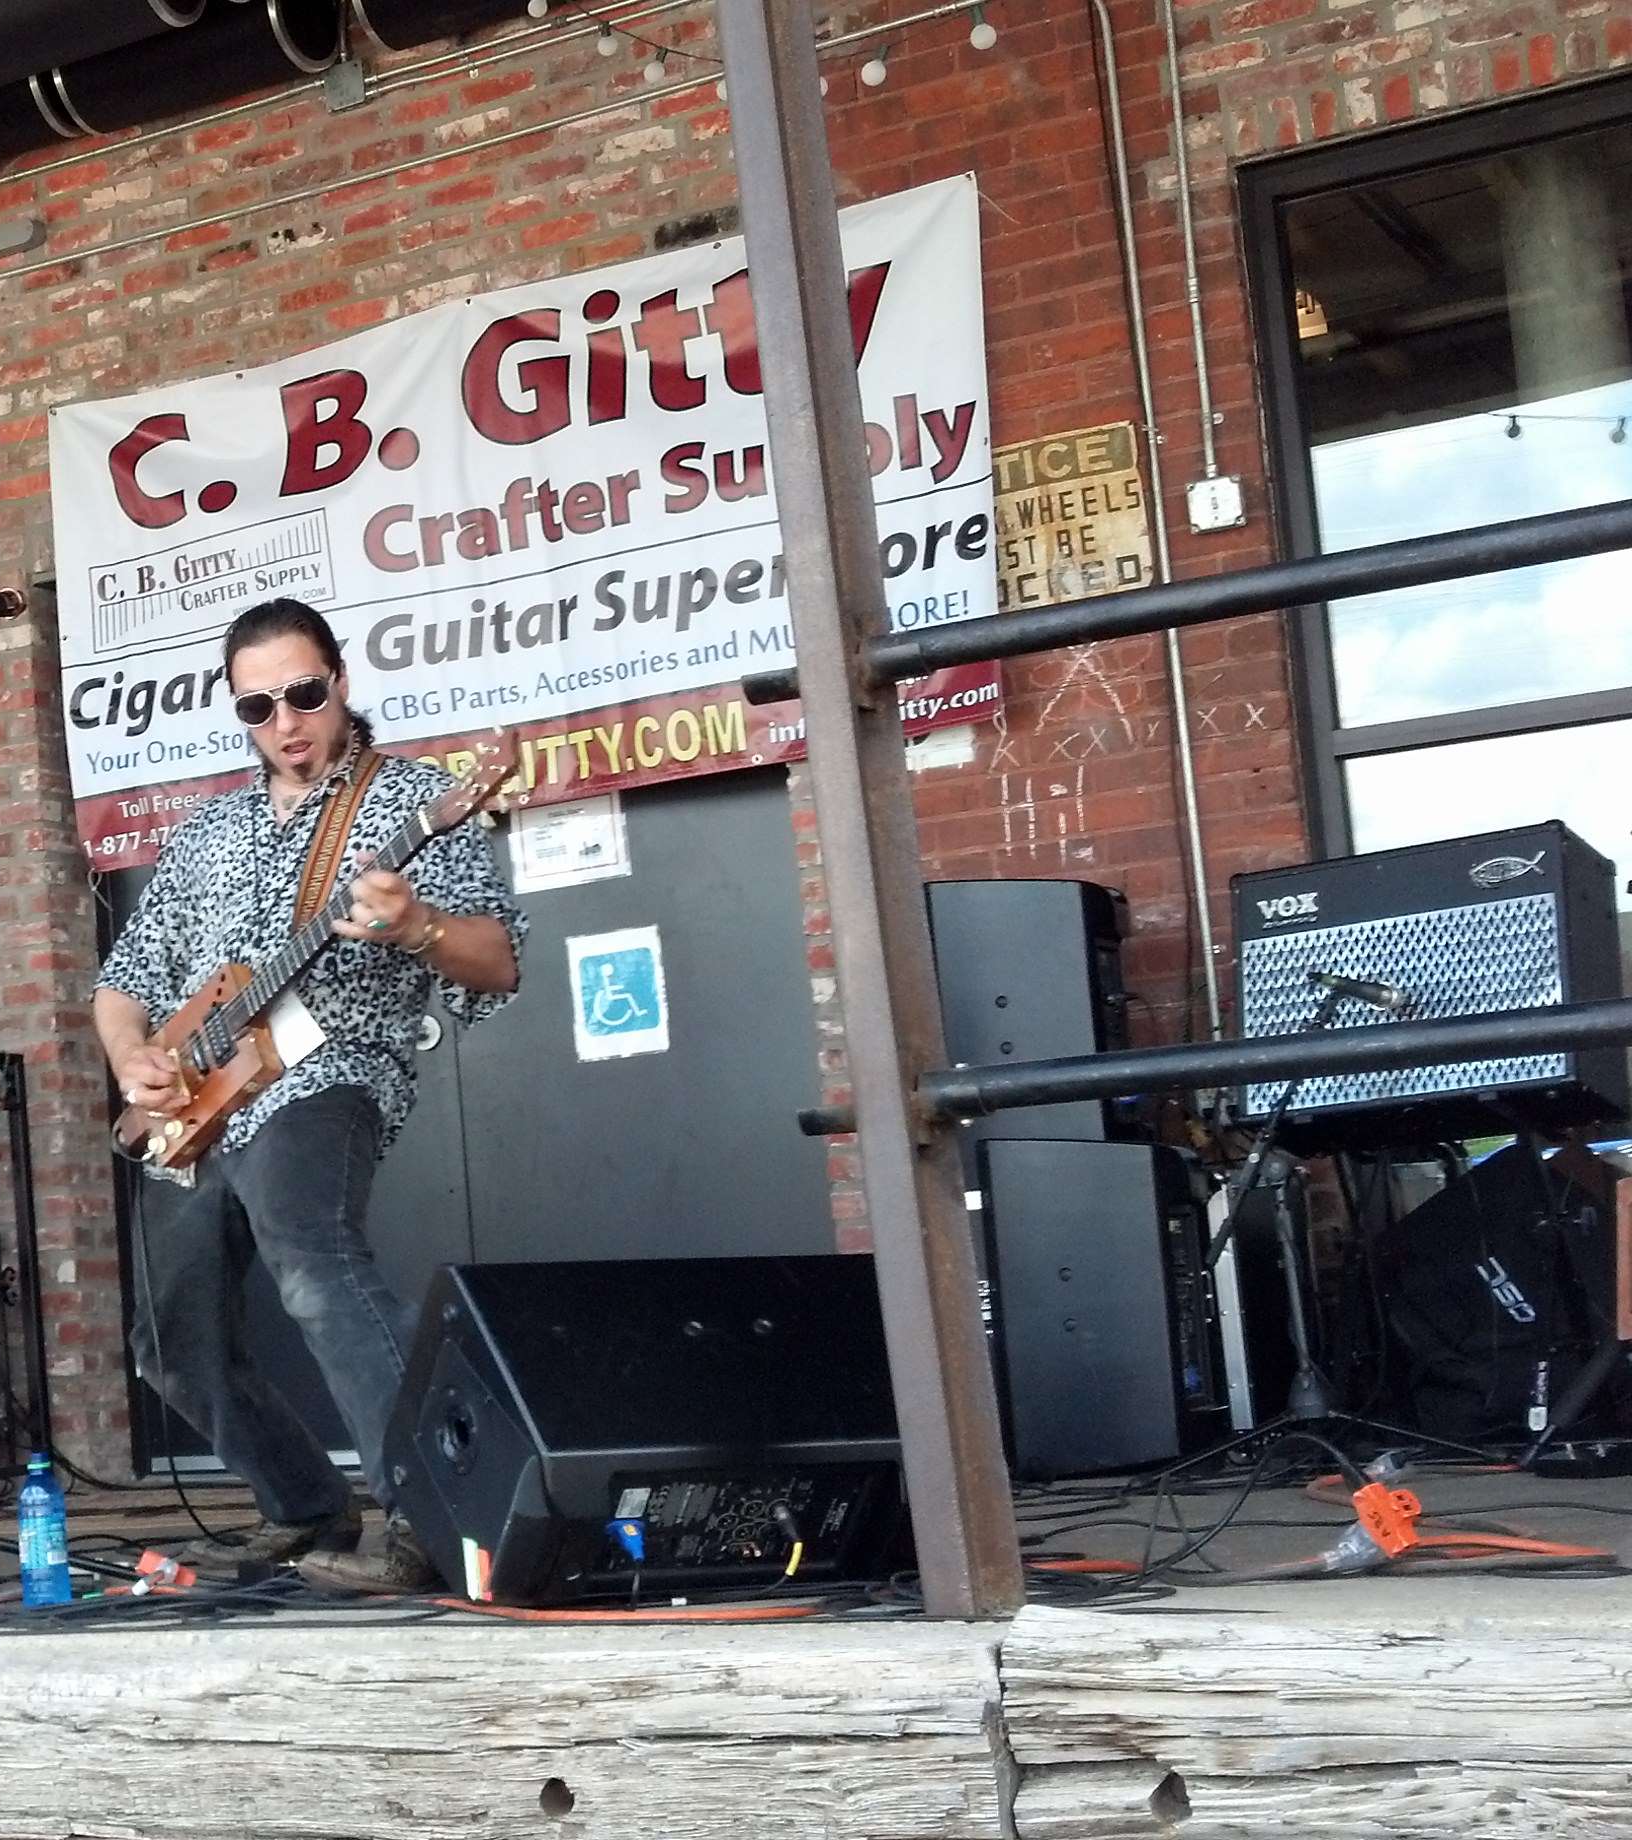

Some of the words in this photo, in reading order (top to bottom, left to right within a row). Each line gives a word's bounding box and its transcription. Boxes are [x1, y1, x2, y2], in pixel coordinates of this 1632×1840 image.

[108, 412, 239, 530] C.
[278, 367, 421, 498] B.
[993, 433, 1113, 490] TICE
[362, 468, 642, 574] Crafter
[659, 392, 977, 515] Suly
[1015, 478, 1141, 530] WHEELS
[1055, 523, 1098, 561] BE
[96, 573, 126, 602] C.
[137, 564, 166, 595] B.
[68, 664, 224, 737] Cigar
[365, 594, 579, 673] Guitar
[593, 512, 990, 633] Superore
[86, 748, 139, 776] Your
[381, 690, 442, 722] CBG
[449, 681, 529, 713] Parts,
[534, 648, 679, 698] Accessories
[686, 630, 740, 667] and
[888, 588, 971, 634] ORE!
[117, 797, 150, 819] Toll
[153, 793, 201, 814] Free:
[1257, 891, 1319, 920] VOX
